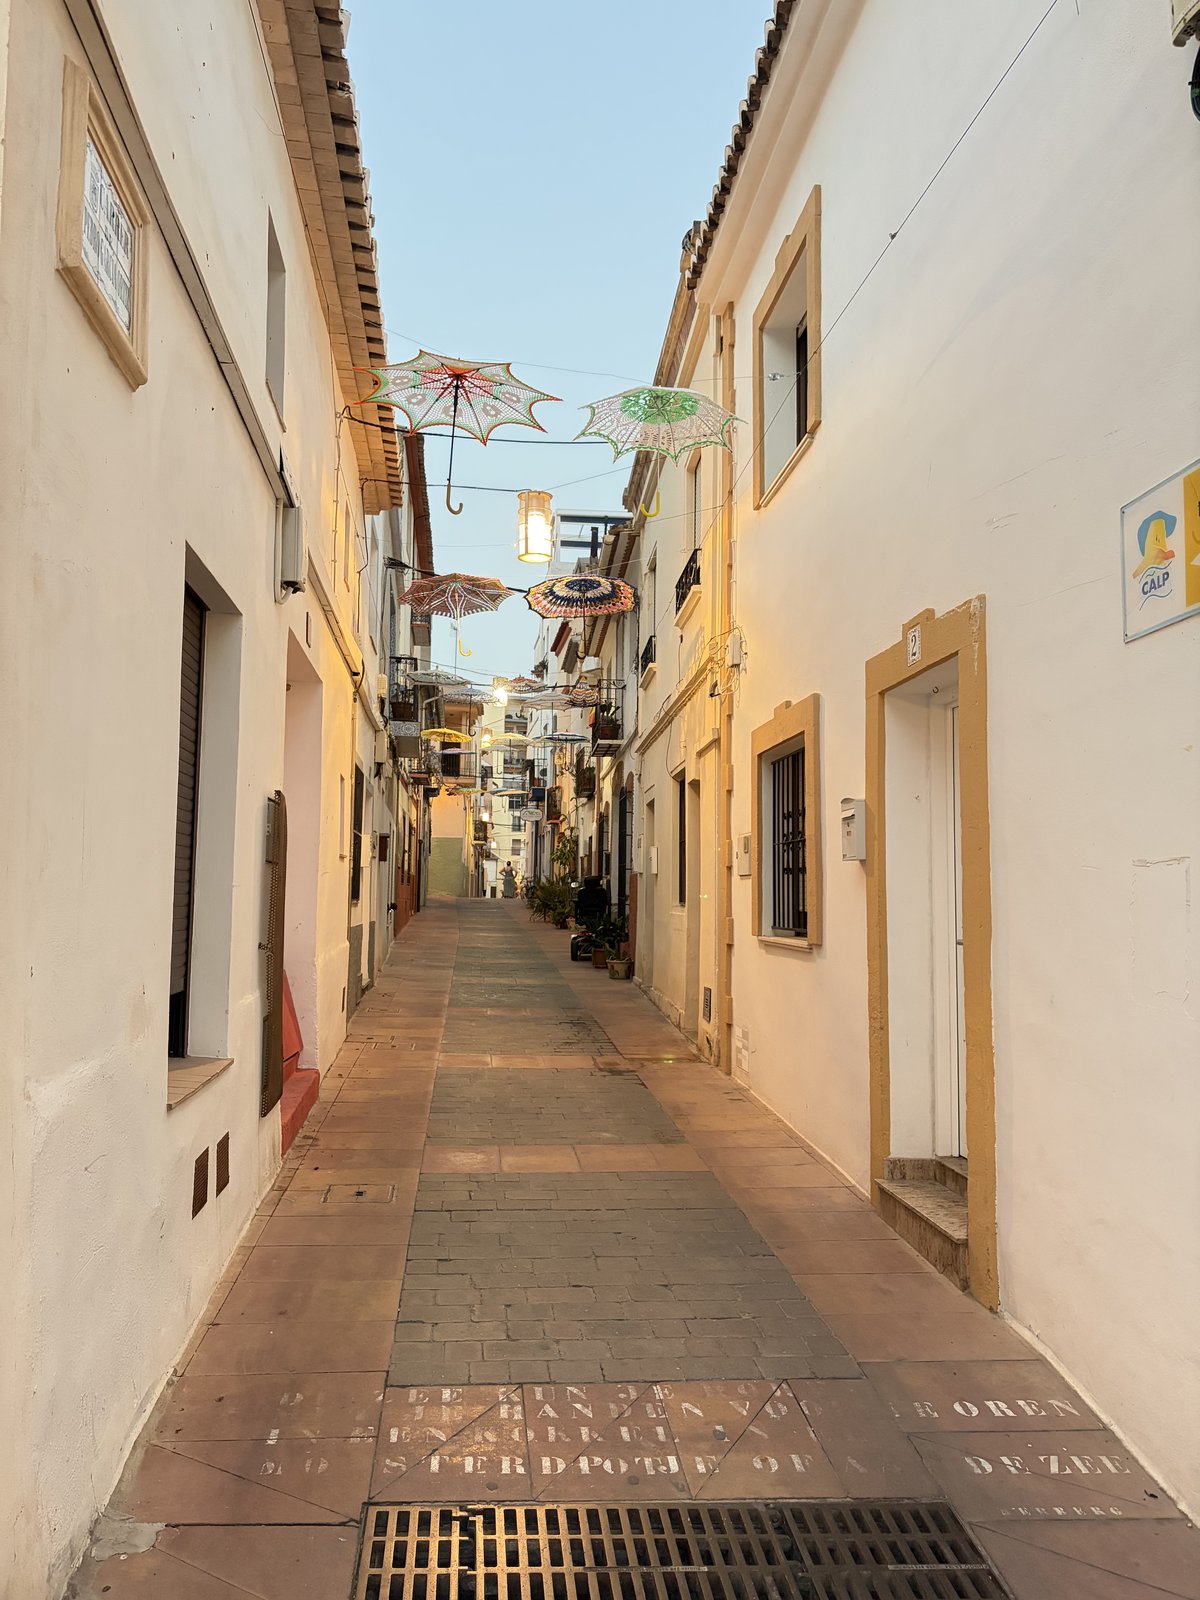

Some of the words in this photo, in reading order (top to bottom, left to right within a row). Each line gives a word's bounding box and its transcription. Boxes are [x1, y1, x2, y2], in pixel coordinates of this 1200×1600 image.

[1141, 571, 1169, 595] CALP
[911, 634, 917, 657] 2
[499, 1385, 587, 1401] KUN
[616, 1384, 674, 1400] JE
[500, 1402, 704, 1419] HANDEN
[953, 1400, 1082, 1417] OREN
[752, 1454, 814, 1473] OF
[964, 1456, 1032, 1475] DE
[1039, 1455, 1131, 1474] ZEE
